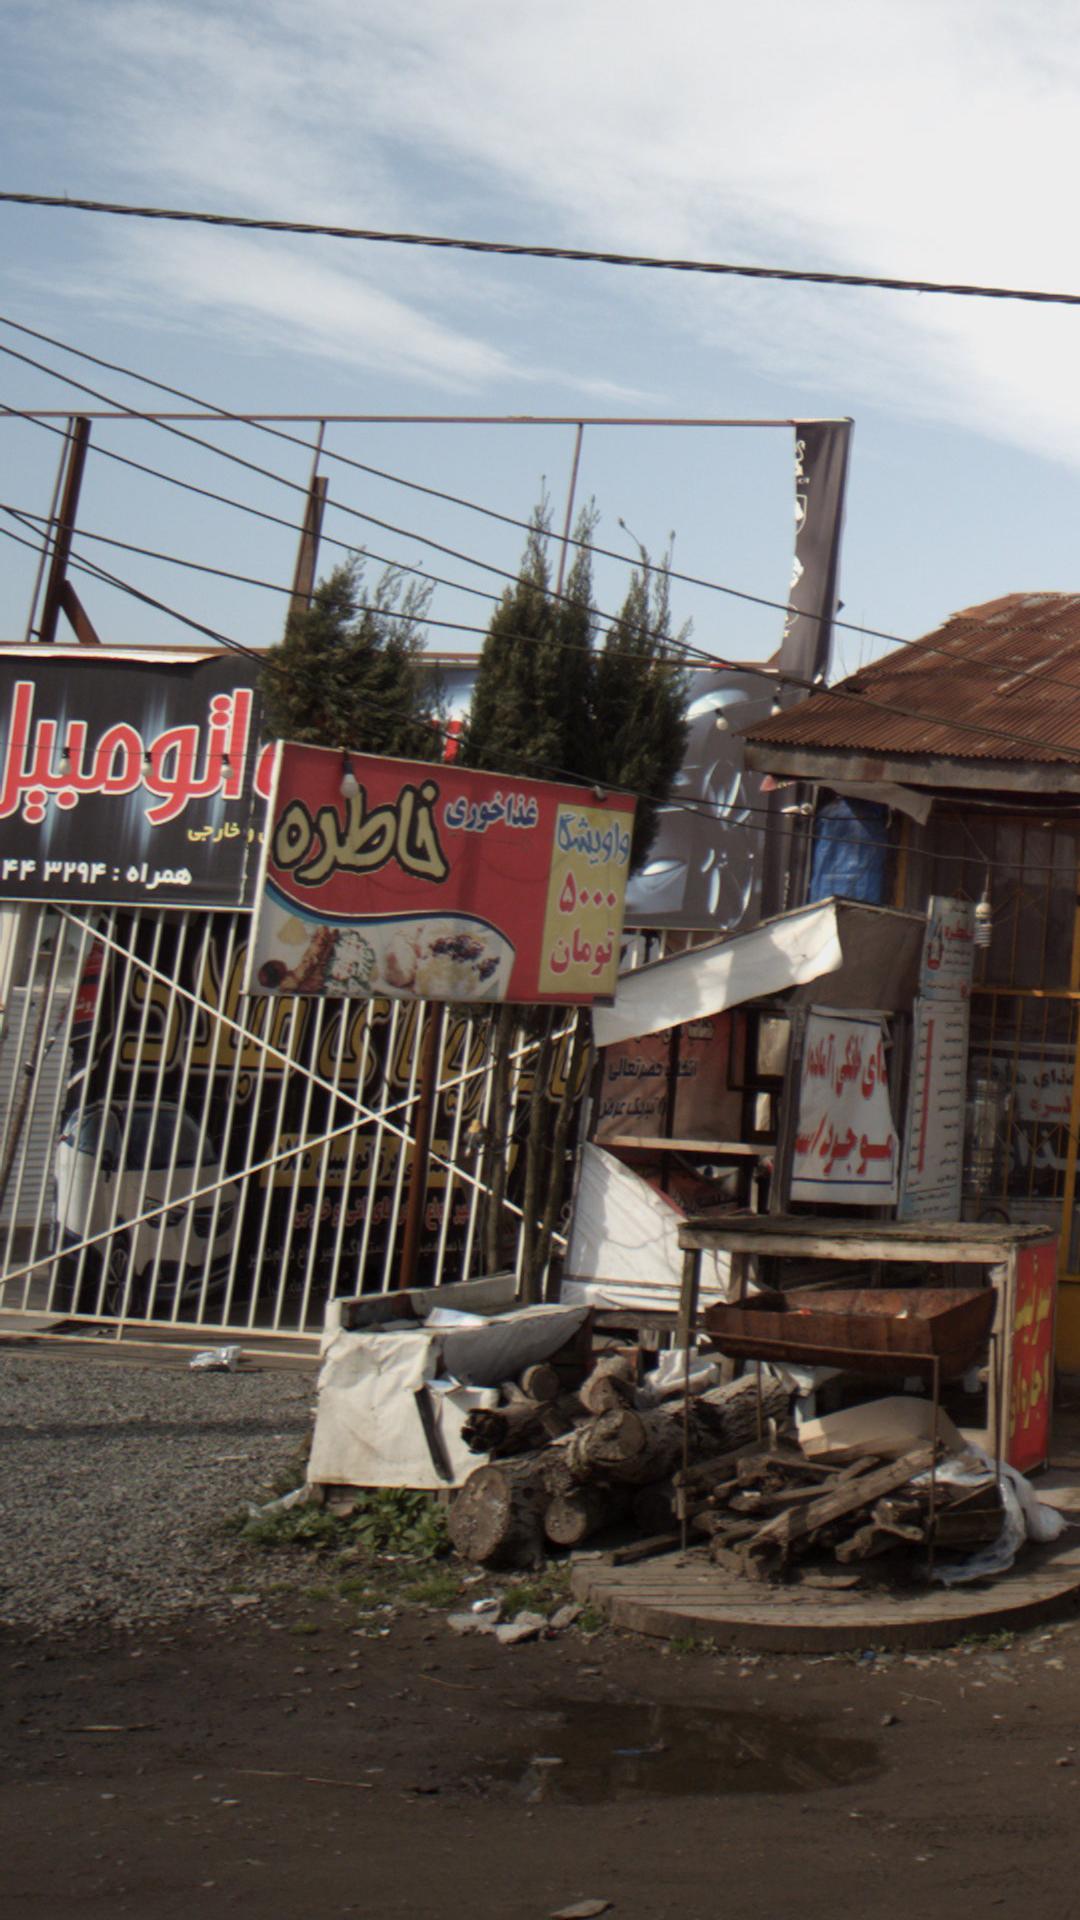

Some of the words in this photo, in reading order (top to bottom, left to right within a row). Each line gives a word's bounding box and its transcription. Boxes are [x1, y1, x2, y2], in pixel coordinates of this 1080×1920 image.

[0, 681, 253, 825] اتومبیل
[187, 822, 241, 843] خارجی
[272, 779, 449, 886] خاطره
[126, 866, 193, 891] همراه
[558, 870, 618, 914] ۵۰۰۰
[549, 927, 615, 977] تومان
